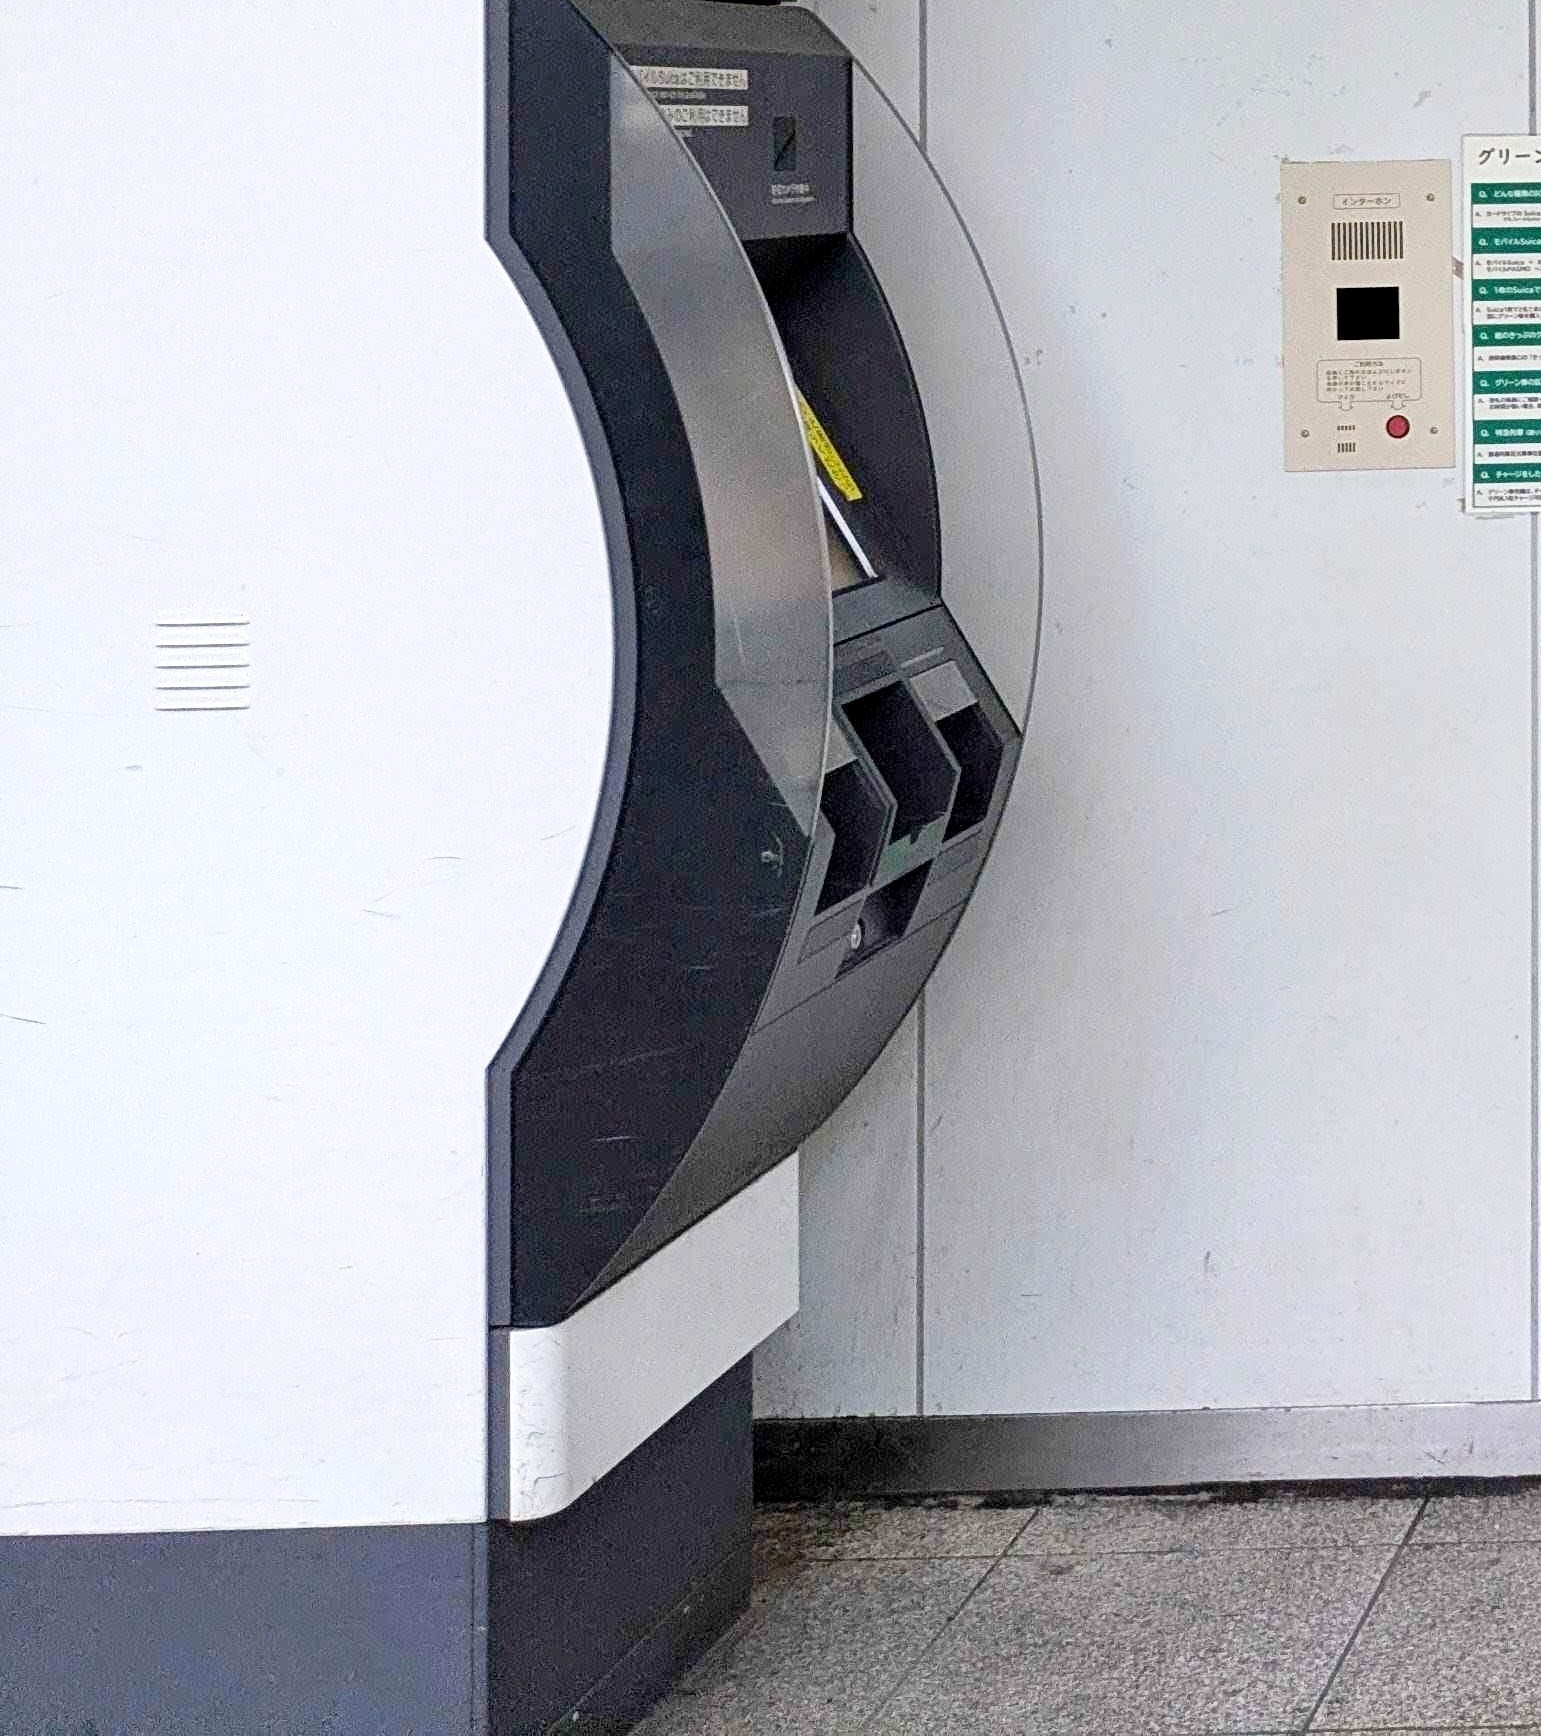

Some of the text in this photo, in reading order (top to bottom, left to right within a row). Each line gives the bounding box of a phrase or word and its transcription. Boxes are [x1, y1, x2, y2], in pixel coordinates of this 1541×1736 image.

[1342, 197, 1391, 206] インターホン
